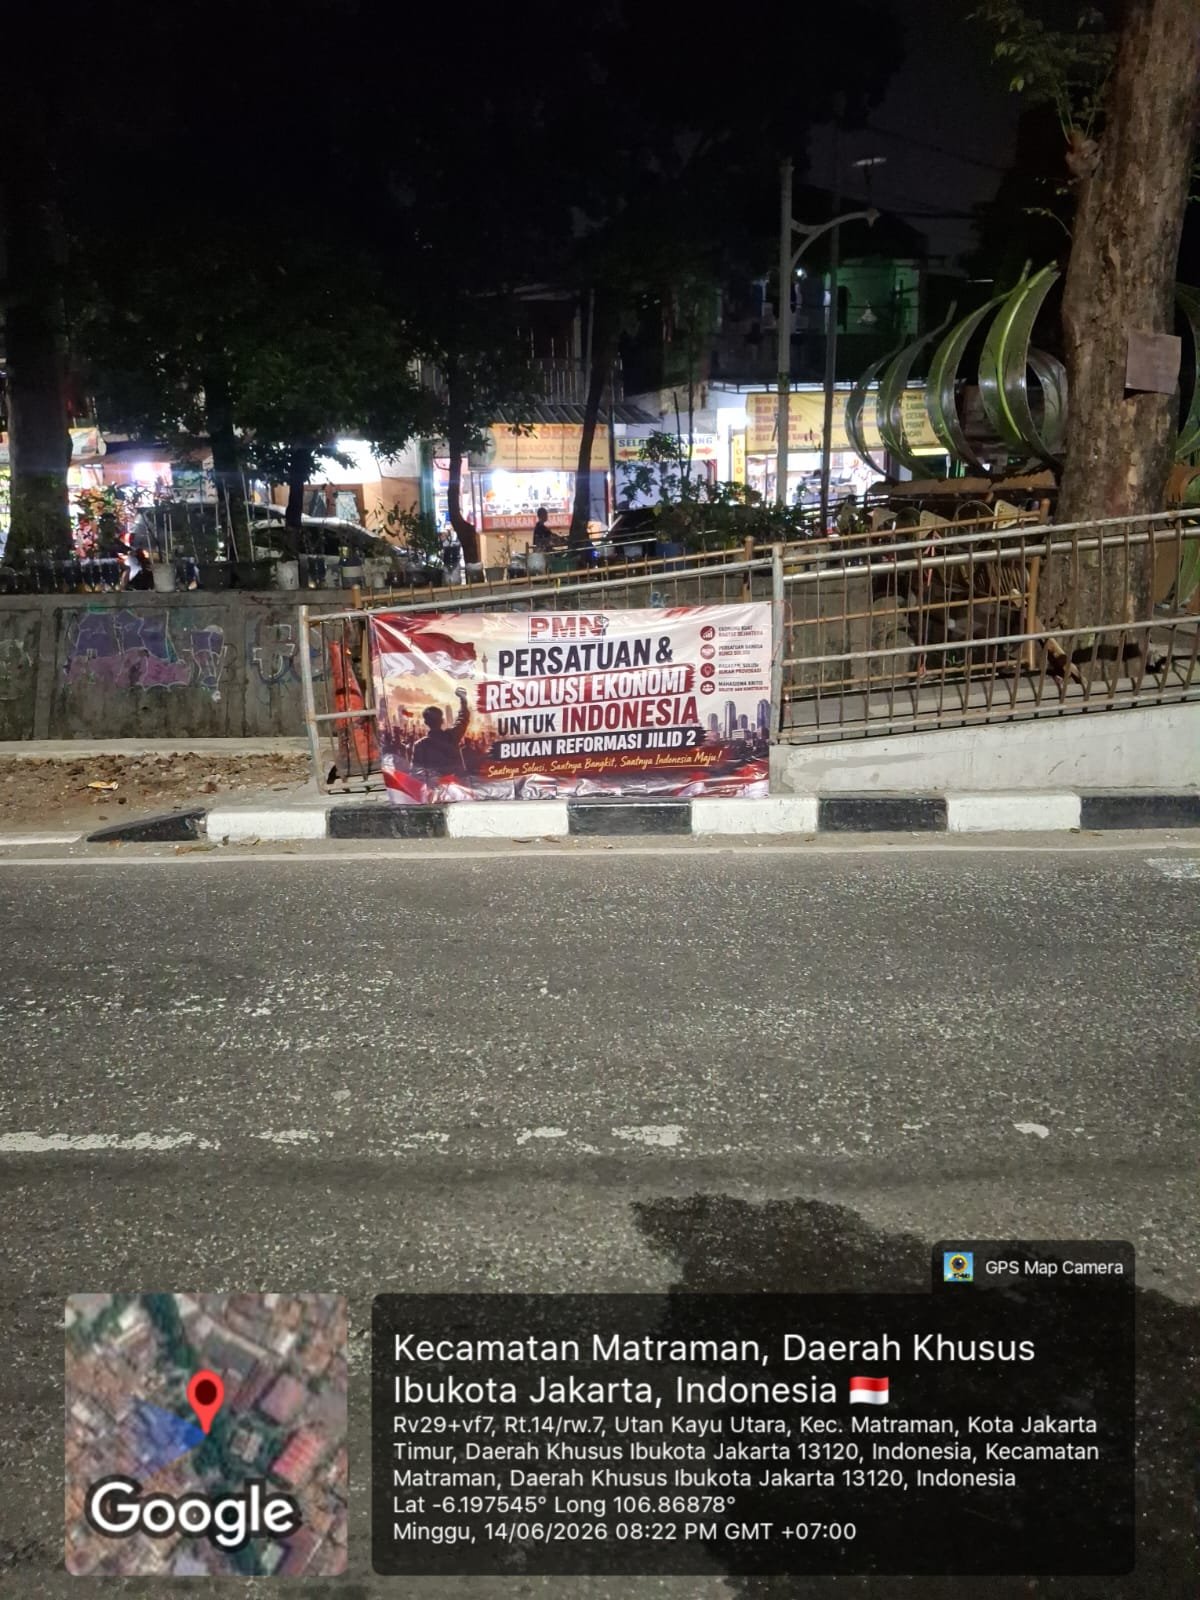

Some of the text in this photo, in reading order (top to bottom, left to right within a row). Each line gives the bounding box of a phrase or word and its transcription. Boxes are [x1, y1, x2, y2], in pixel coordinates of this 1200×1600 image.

[530, 616, 604, 638] PMN
[498, 636, 673, 678] PERSATUAN &
[486, 667, 687, 712] RESOLUSI EKONOMI
[497, 696, 699, 737] UNTUK INDONESIA
[500, 730, 696, 759] BUKAN REFORMASI JILID 2
[487, 765, 520, 778] Saatnya
[550, 759, 583, 773] Saatnya
[584, 756, 617, 772] Bangkit,
[620, 754, 653, 768] Saatnya
[655, 752, 693, 765] Indonesia
[694, 750, 723, 766] Maju!
